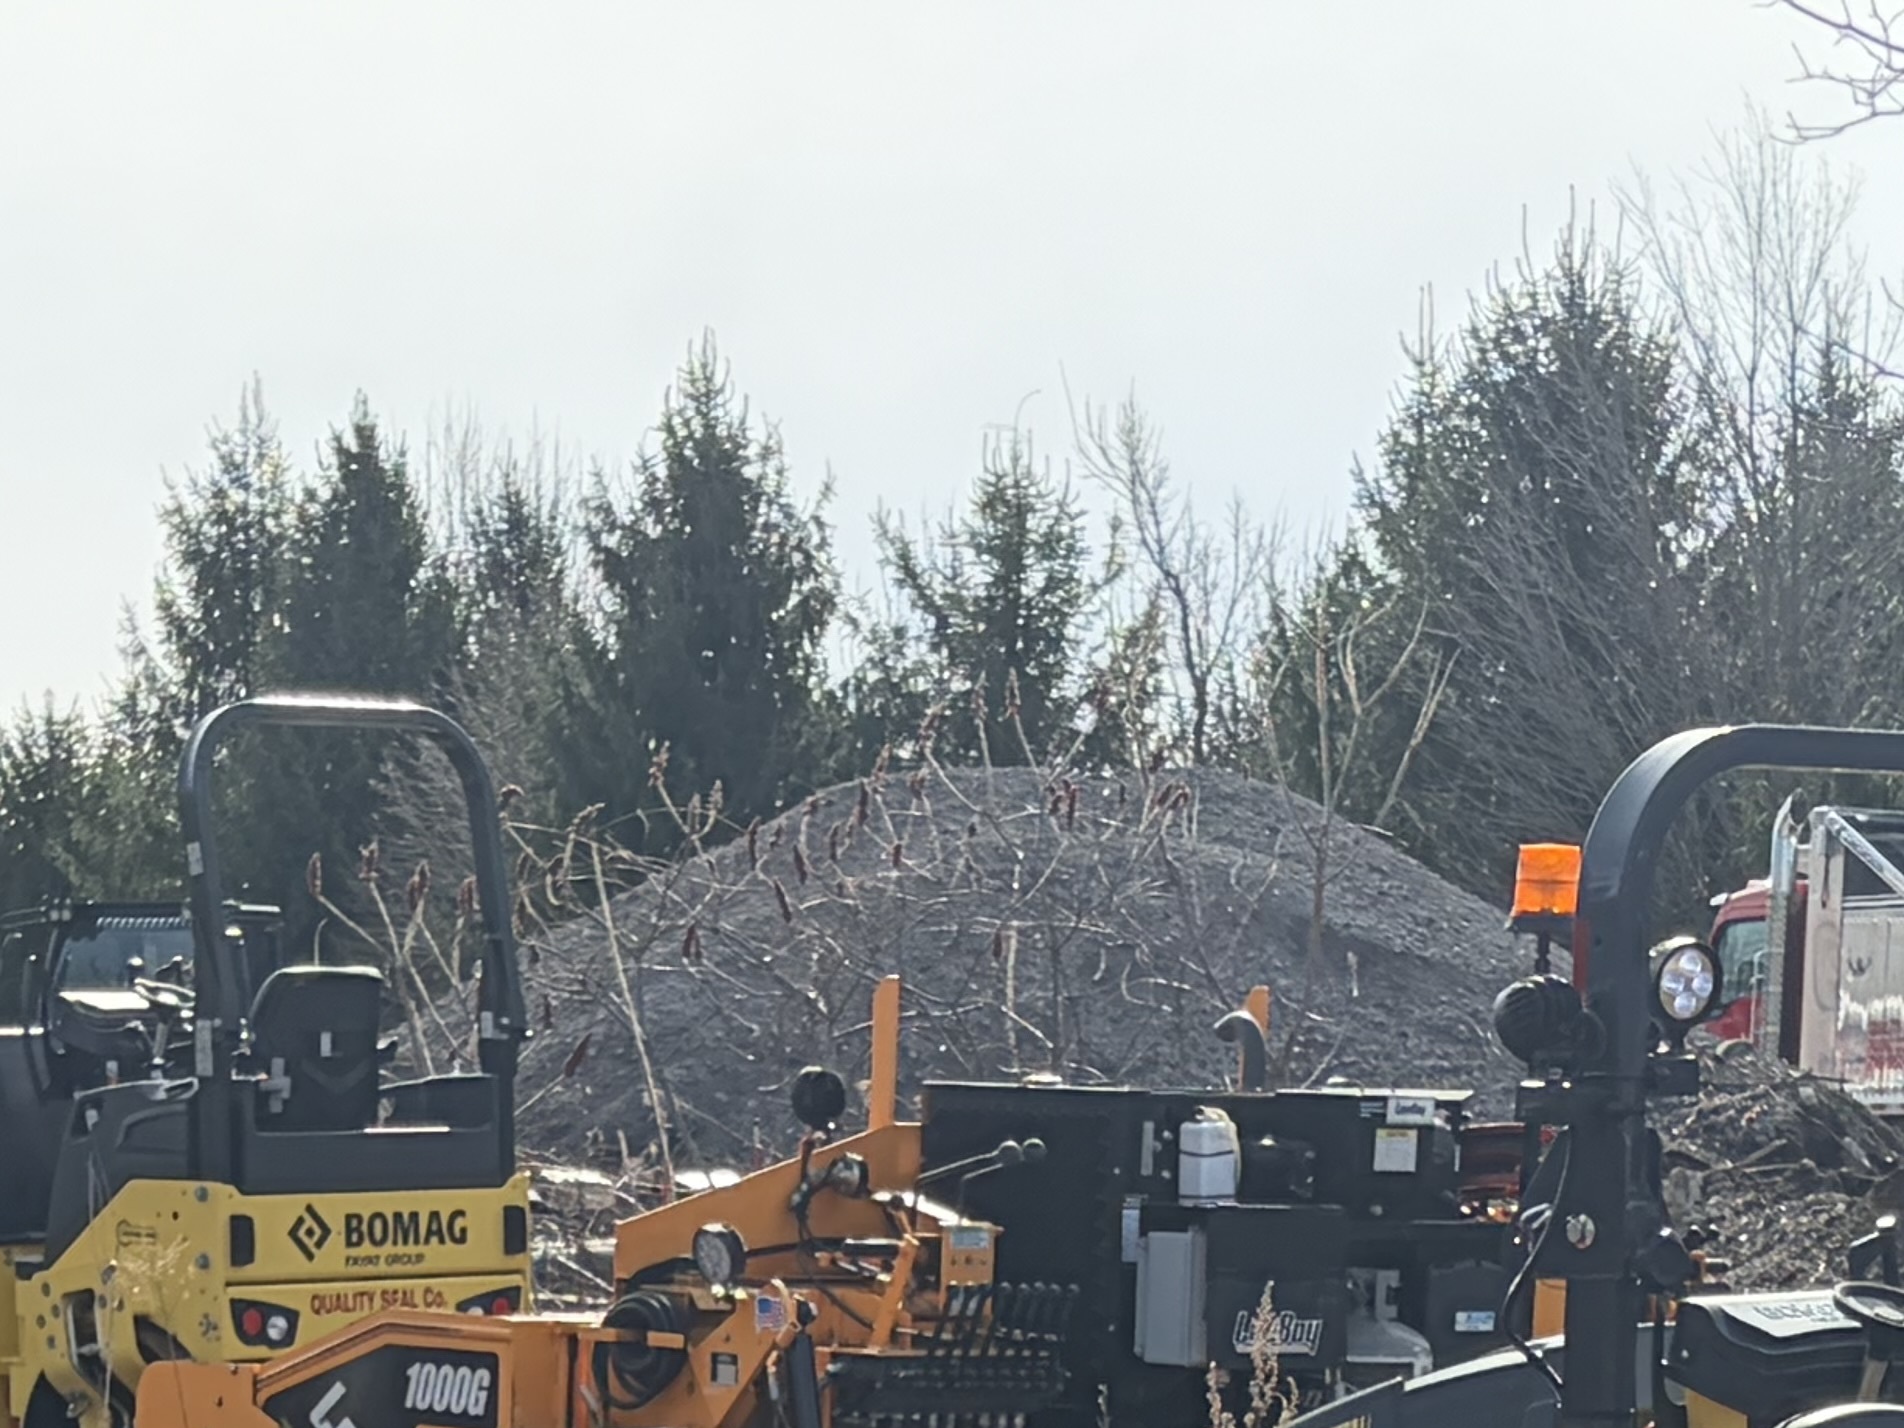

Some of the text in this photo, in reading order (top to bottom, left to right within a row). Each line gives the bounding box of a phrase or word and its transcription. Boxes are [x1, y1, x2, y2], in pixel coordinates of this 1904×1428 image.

[345, 1210, 468, 1249] BOMAG
[345, 1252, 425, 1269] FAYAT GROUP
[310, 1290, 375, 1317] QUALITY
[380, 1288, 418, 1311] SEAL
[1233, 1310, 1323, 1356] LeBoy
[404, 1361, 491, 1417] 1000G
